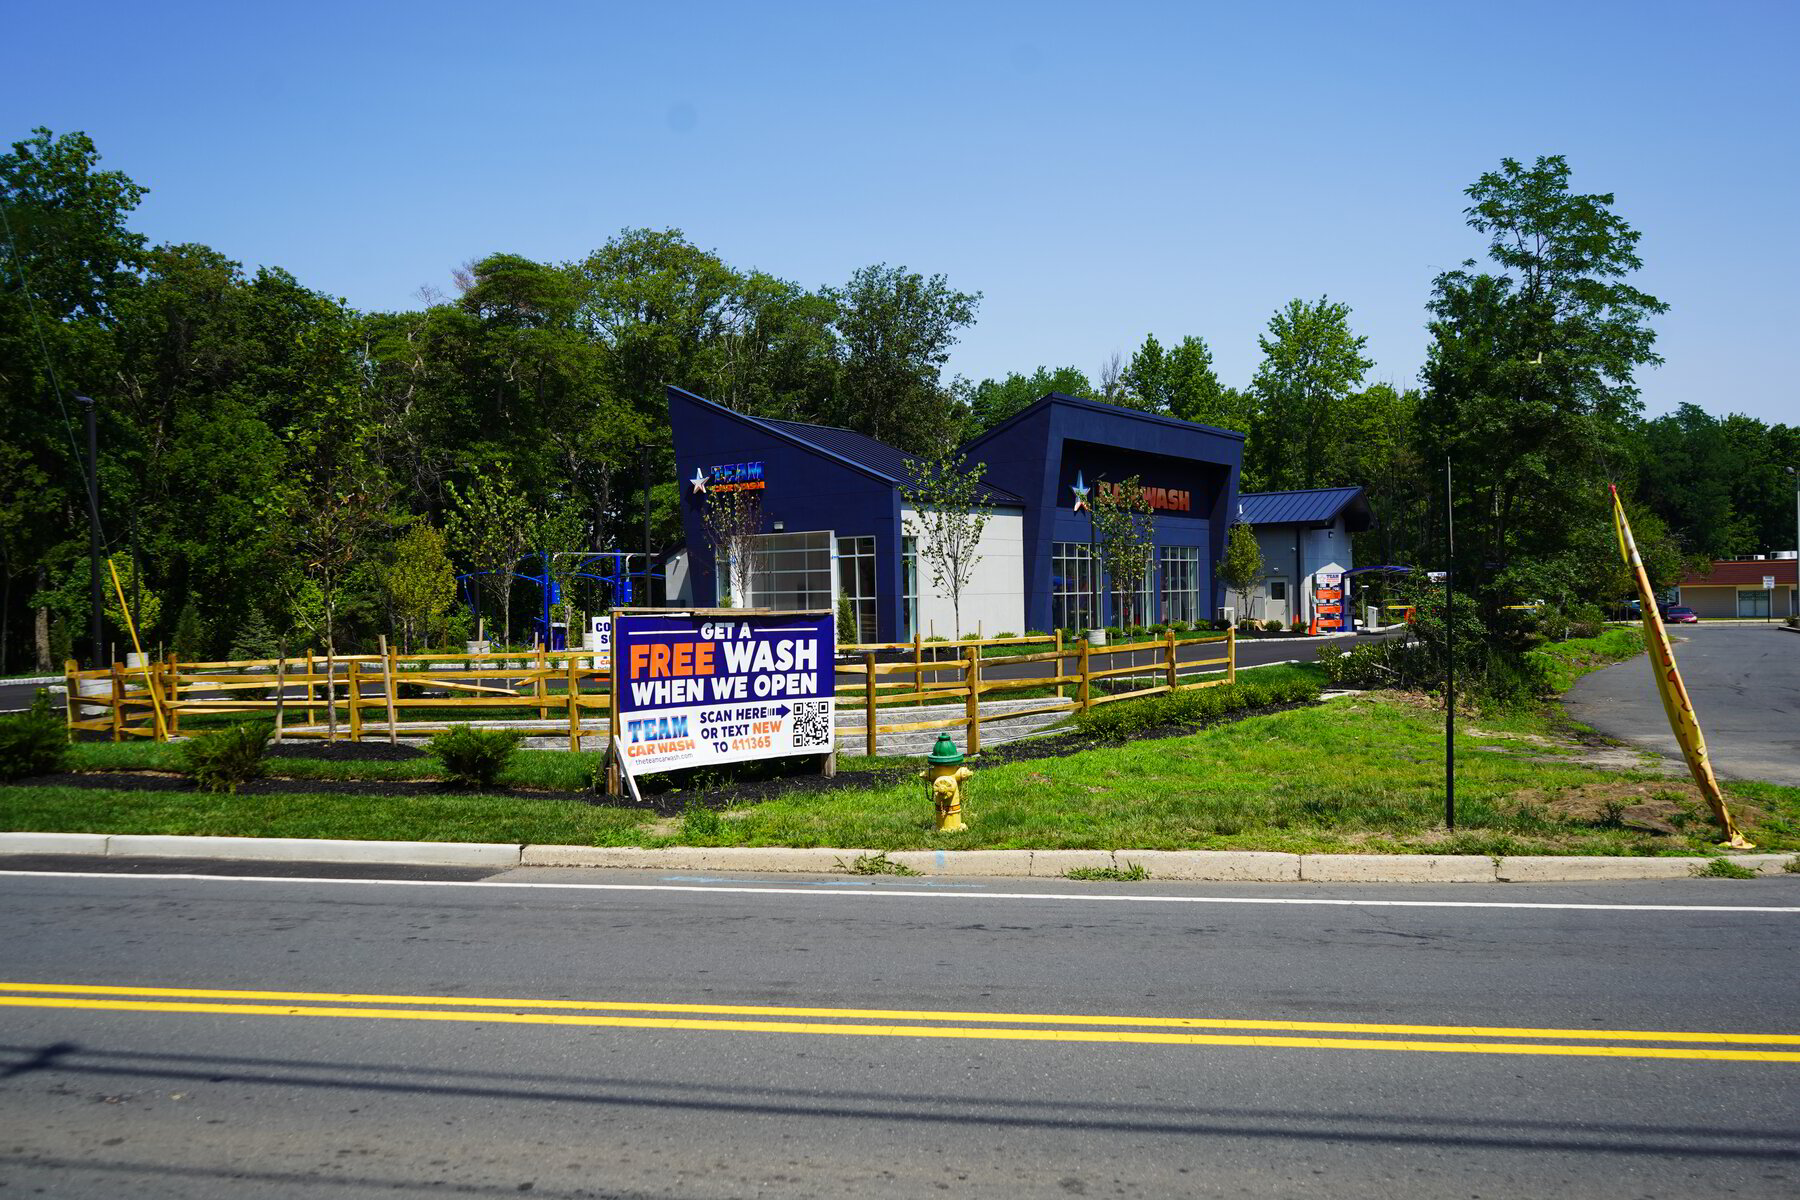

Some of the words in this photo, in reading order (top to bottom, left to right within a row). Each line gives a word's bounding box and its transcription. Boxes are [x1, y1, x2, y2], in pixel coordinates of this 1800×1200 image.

[1140, 486, 1190, 512] WASH
[700, 622, 735, 640] GET
[738, 622, 752, 639] A
[630, 642, 716, 679] FREE
[722, 639, 818, 674] WASH
[631, 678, 704, 707] WHEN
[711, 676, 748, 700] WE
[753, 672, 817, 697] OPEN
[700, 709, 732, 724] SCAN
[736, 706, 768, 720] HERE
[627, 715, 689, 743] TEAM
[701, 727, 719, 739] OR
[721, 724, 750, 738] TEXT
[752, 720, 782, 735] NEW
[628, 743, 656, 758] CAR
[657, 739, 696, 753] WASH
[712, 741, 729, 753] TO
[732, 736, 771, 751] 411365
